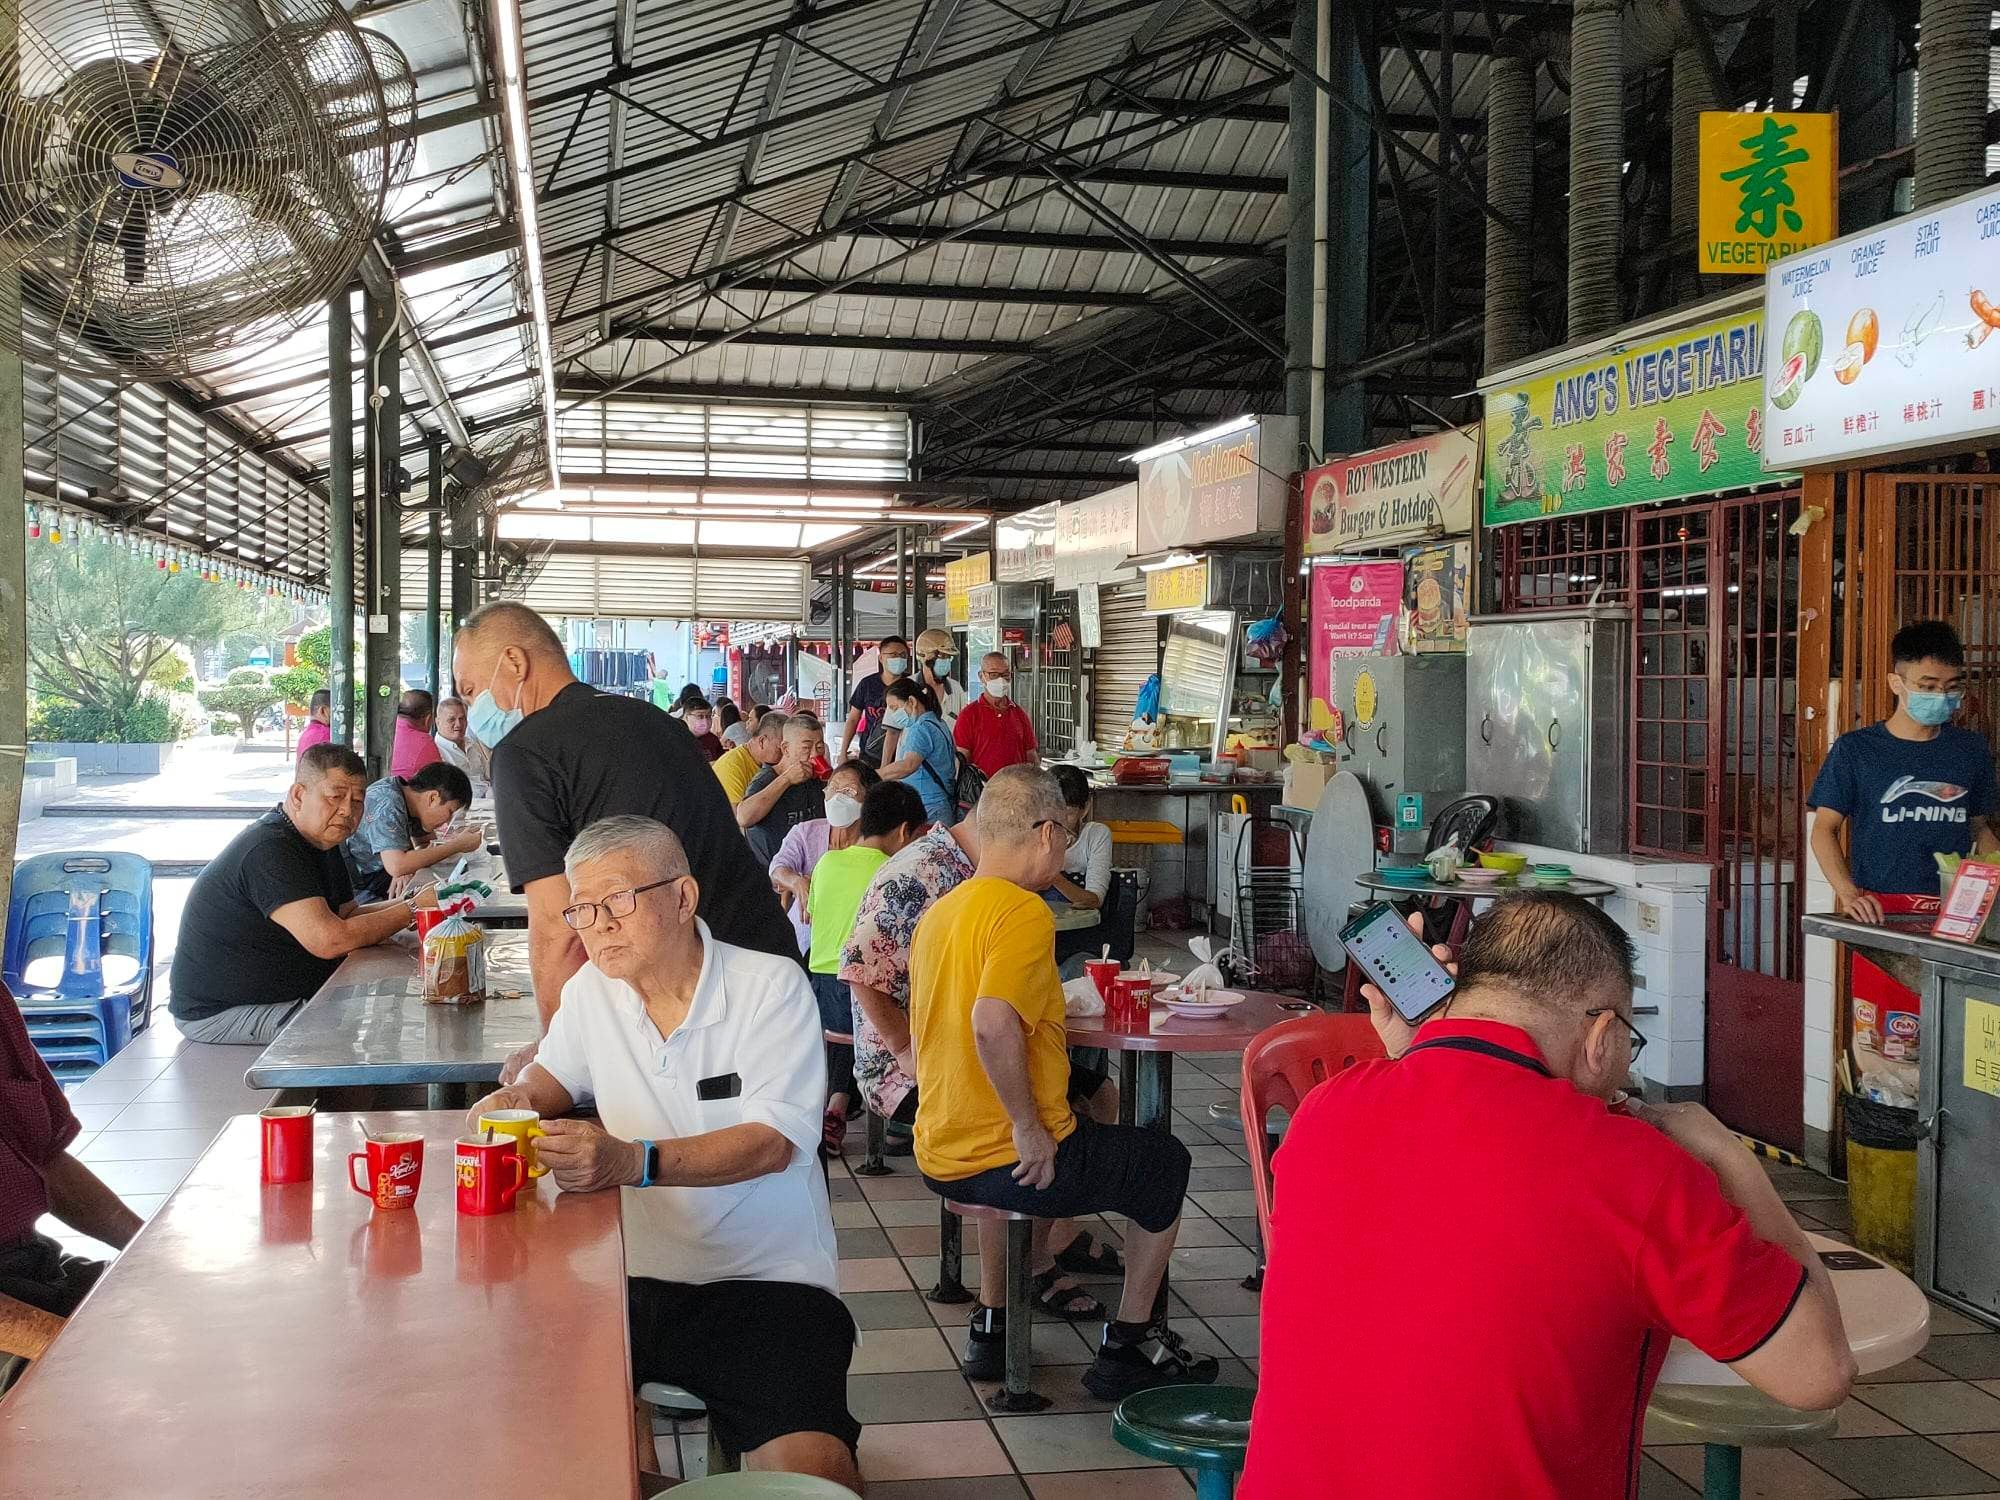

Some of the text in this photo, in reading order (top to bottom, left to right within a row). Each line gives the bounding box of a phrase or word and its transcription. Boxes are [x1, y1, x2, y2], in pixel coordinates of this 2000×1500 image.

[1720, 116, 1810, 239] 素
[1916, 221, 1940, 242] STAR
[1851, 239, 1886, 264] ORANGE
[1914, 235, 1941, 259] FRUIT
[1781, 257, 1832, 287] WATERMELON
[1855, 257, 1879, 279] JUICE
[1792, 279, 1813, 299] JUICE
[1552, 321, 1766, 429] ANG'S VEGETARI
[1783, 423, 1816, 447] 西瓜汁
[1346, 448, 1429, 496] ROY WESTERN
[1340, 492, 1434, 539] Burger & Hotdog
[1330, 596, 1382, 610] foodpanda
[1881, 806, 1967, 823] LI-NING
